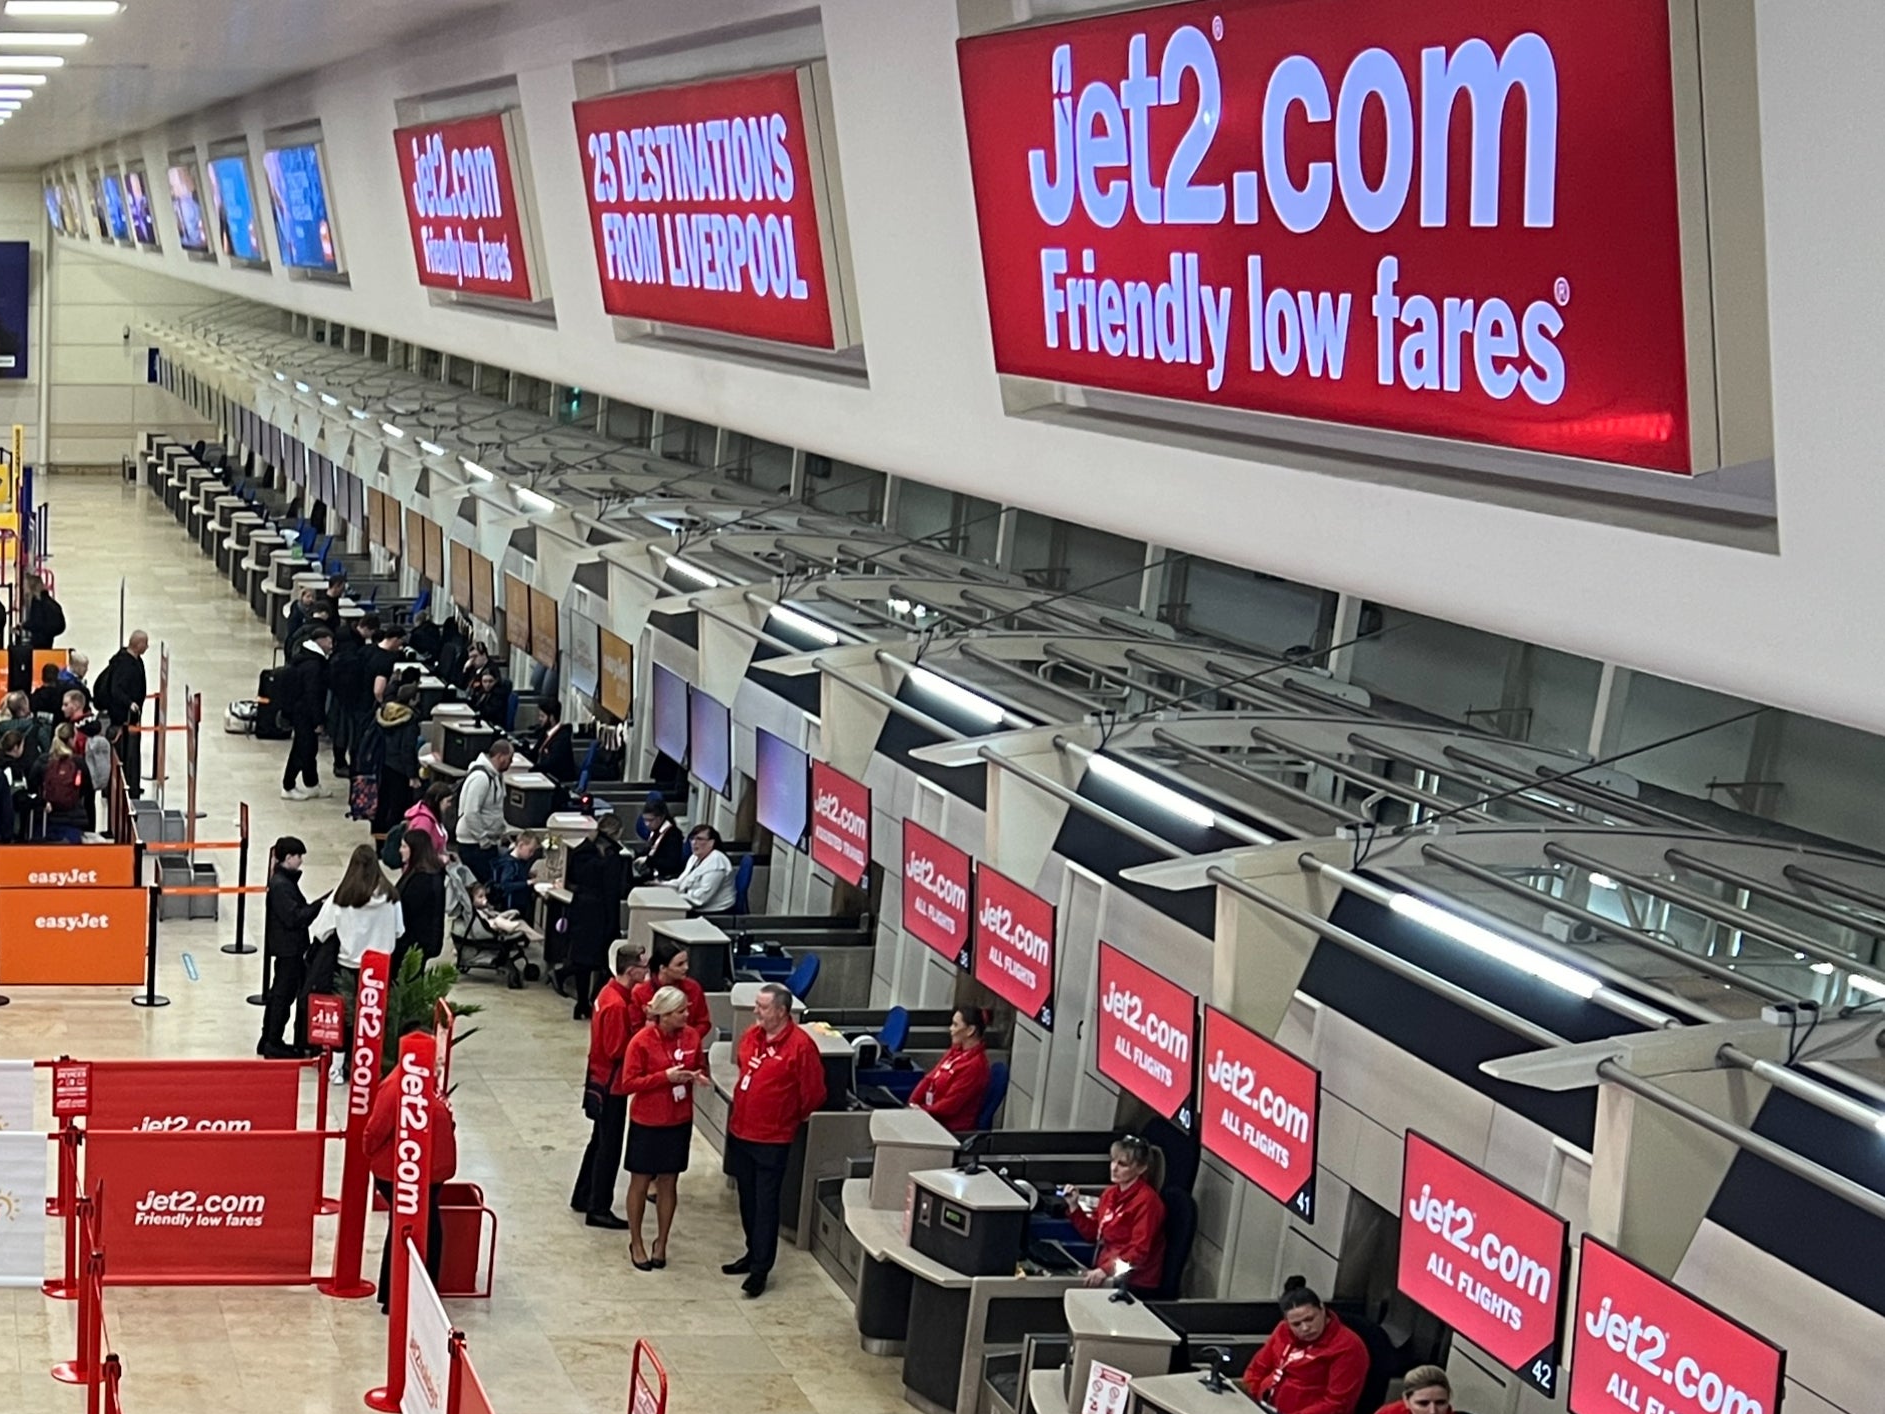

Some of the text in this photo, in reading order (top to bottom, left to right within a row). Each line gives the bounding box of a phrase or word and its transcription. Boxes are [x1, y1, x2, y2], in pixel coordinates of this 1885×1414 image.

[588, 113, 795, 203] 25 DESTINATIONS
[1028, 25, 1560, 234] Jet2.com
[412, 132, 502, 220] Jet2.com
[601, 212, 808, 300] FROM LIVERPOOL
[1040, 247, 1568, 406] Friendly low fares
[813, 788, 866, 841] Jet2.com
[27, 869, 97, 886] easyJet
[905, 851, 967, 914] Jet2.com
[914, 895, 928, 917] ALL
[35, 913, 109, 932] easyJet
[978, 898, 1049, 967] Jet2.com
[988, 946, 1004, 967] ALL
[351, 968, 385, 1115] Jet2.com
[1102, 981, 1189, 1063] Jet2.com
[1115, 1035, 1173, 1088] ALL FLIGHTS
[1178, 1107, 1191, 1129] 40
[1207, 1049, 1310, 1143] Jet2.com
[396, 1053, 431, 1216] Jet2.com
[1220, 1108, 1290, 1170] ALL FLIGHTS
[134, 1212, 263, 1229] Friendly low fares
[135, 1190, 265, 1213] Jet2.com
[1296, 1192, 1310, 1216] 41
[1409, 1184, 1551, 1304] Jet2.com
[1426, 1251, 1523, 1331] ALL FLIGHTS
[1531, 1359, 1552, 1390] 42
[1605, 1372, 1641, 1413] ALL
